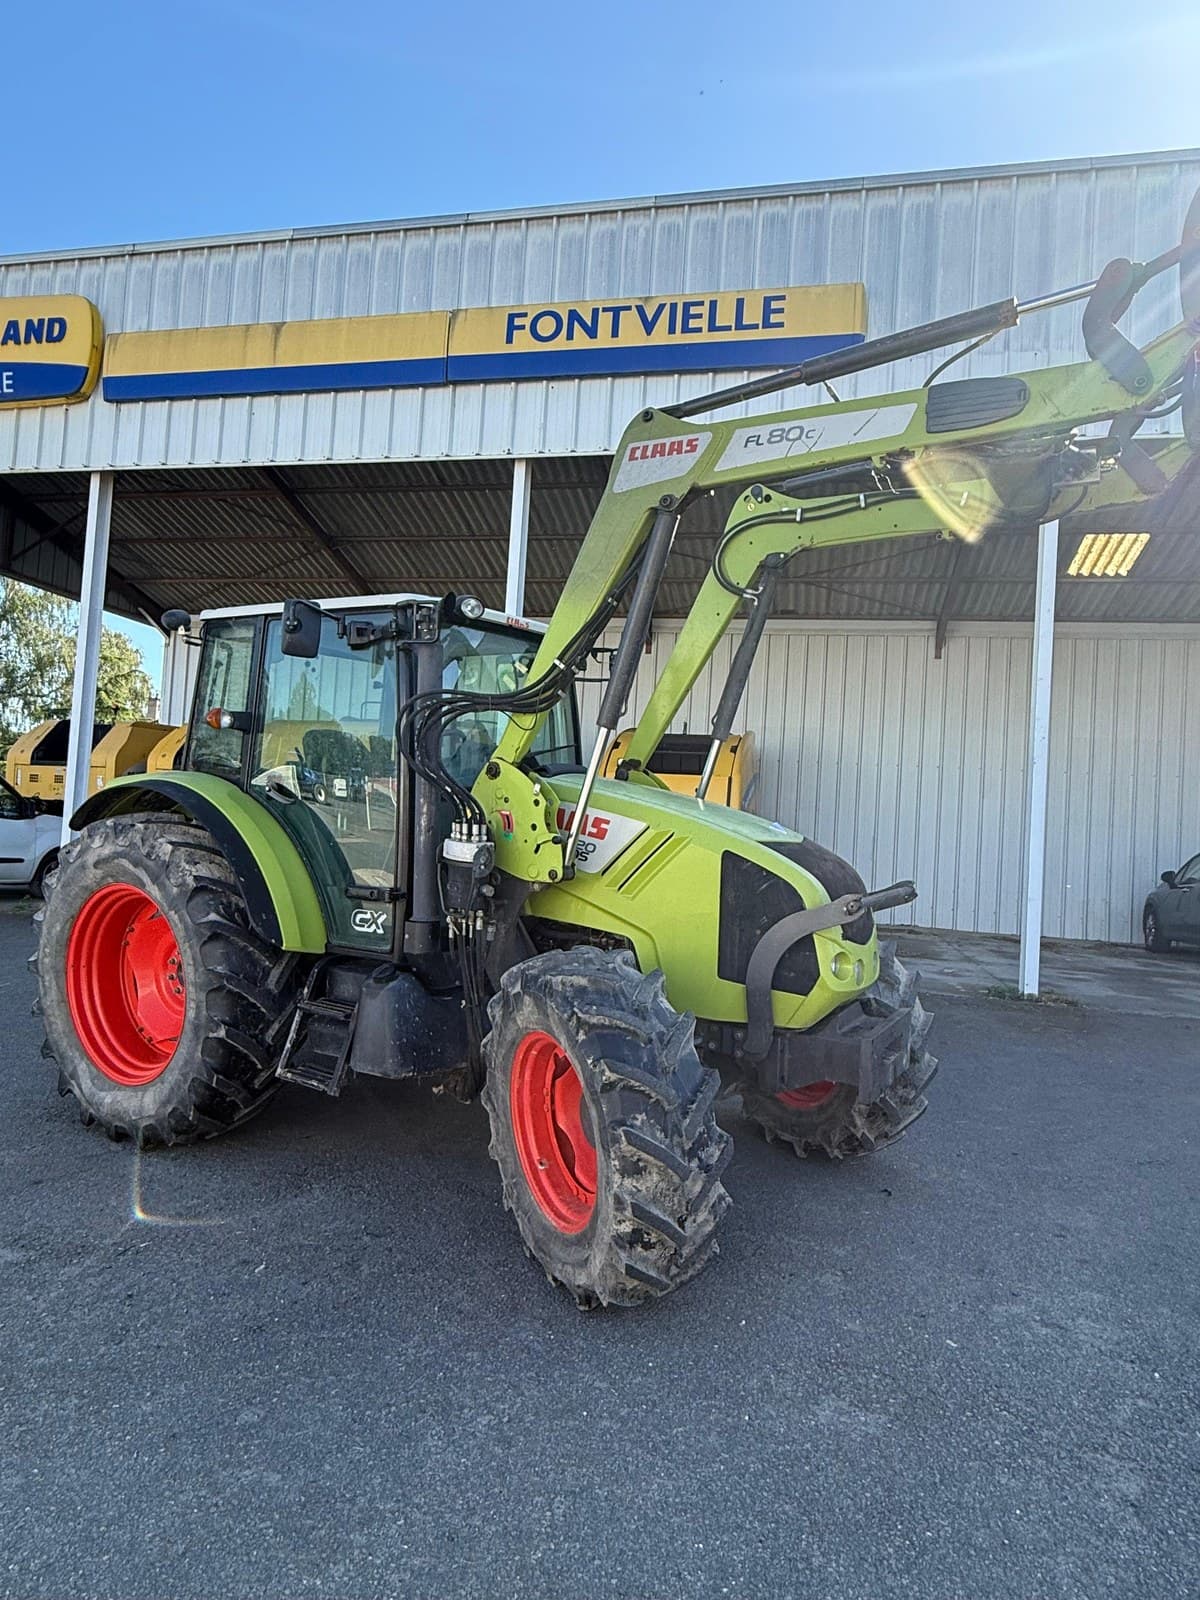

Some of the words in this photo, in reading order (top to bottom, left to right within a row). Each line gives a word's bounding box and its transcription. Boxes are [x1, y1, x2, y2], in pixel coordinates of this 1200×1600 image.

[0, 316, 68, 346] AND
[505, 294, 787, 345] FONTVIELLE
[0, 371, 14, 393] E
[627, 437, 700, 463] CLAAS
[575, 839, 597, 854] 20
